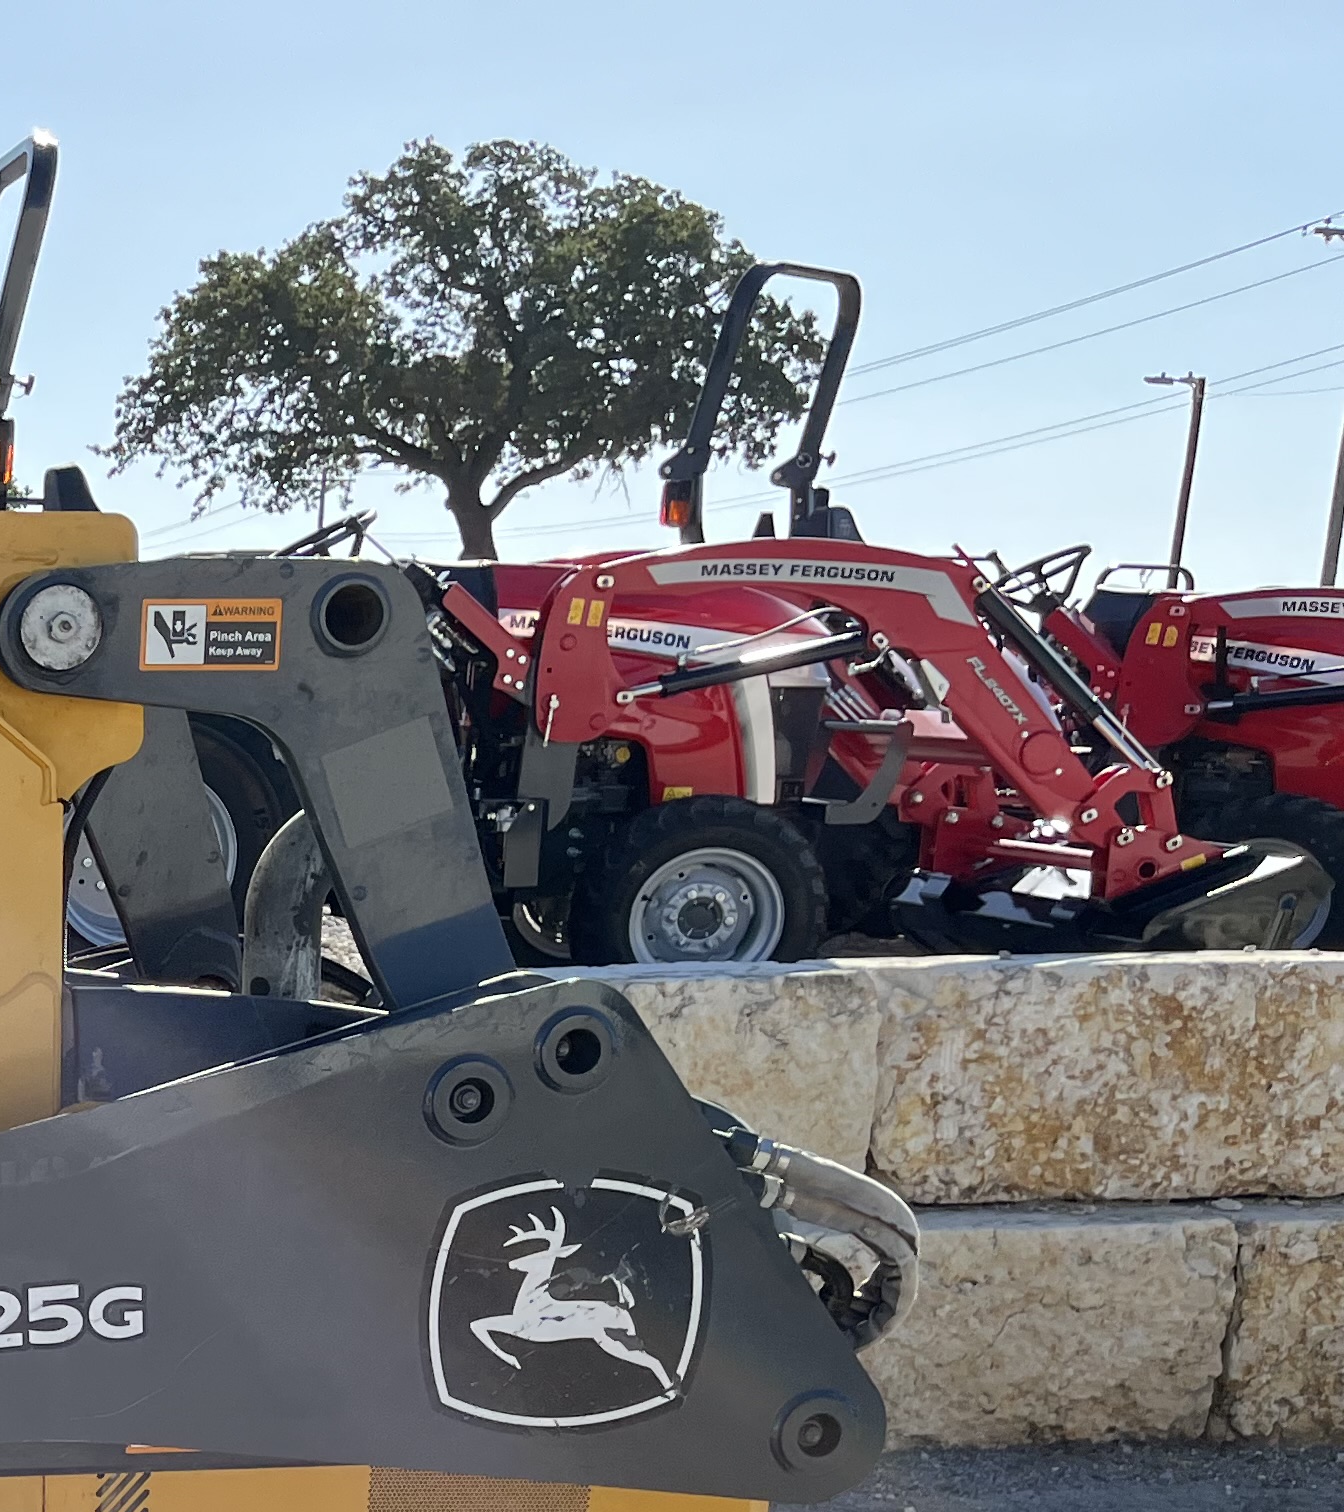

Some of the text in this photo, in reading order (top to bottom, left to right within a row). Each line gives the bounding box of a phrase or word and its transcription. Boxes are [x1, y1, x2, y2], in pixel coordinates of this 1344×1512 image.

[701, 563, 896, 582] MASSEY FERGUSON
[222, 605, 275, 616] WARNING
[1281, 600, 1344, 615] MASSE
[209, 630, 272, 642] Pinch Area
[606, 624, 691, 650] ERGUSON
[208, 646, 263, 658] Keep Away
[1225, 644, 1315, 672] FERGUSON
